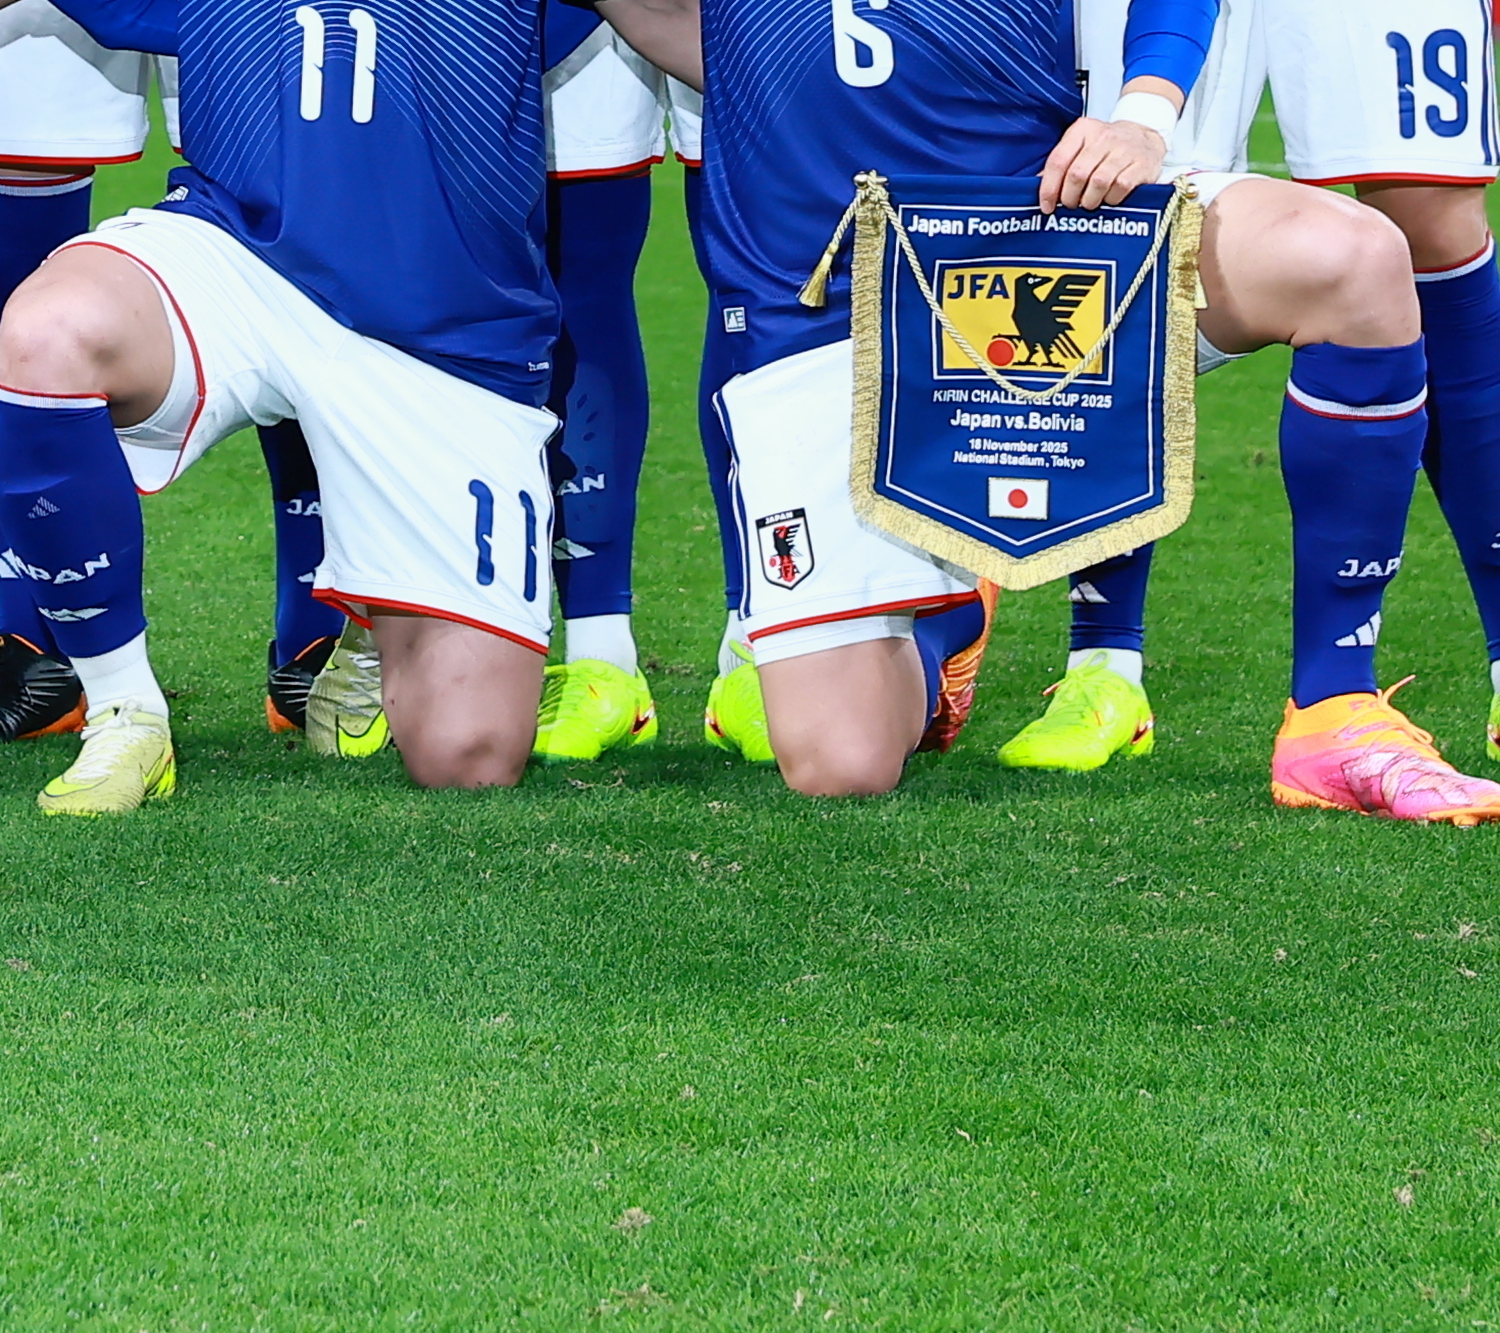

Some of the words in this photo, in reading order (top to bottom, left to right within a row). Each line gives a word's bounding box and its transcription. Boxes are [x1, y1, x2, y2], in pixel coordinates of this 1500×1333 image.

[295, 5, 377, 124] 11
[1385, 28, 1468, 139] 19
[907, 214, 963, 237] Japan
[967, 214, 1041, 235] Football
[1045, 214, 1149, 236] Association
[947, 274, 1010, 300] JFA
[933, 390, 968, 402] KIRIN
[1052, 393, 1079, 406] CUP
[1081, 394, 1112, 409] 2025
[950, 409, 1001, 431] Japan
[969, 438, 981, 451] 18
[983, 439, 1039, 452] November
[1040, 441, 1068, 454] 2025
[953, 451, 998, 465] National
[1052, 455, 1085, 470] Tokyo
[765, 512, 793, 525] JAPAN
[468, 479, 537, 602] 11
[777, 564, 801, 580] JFA
